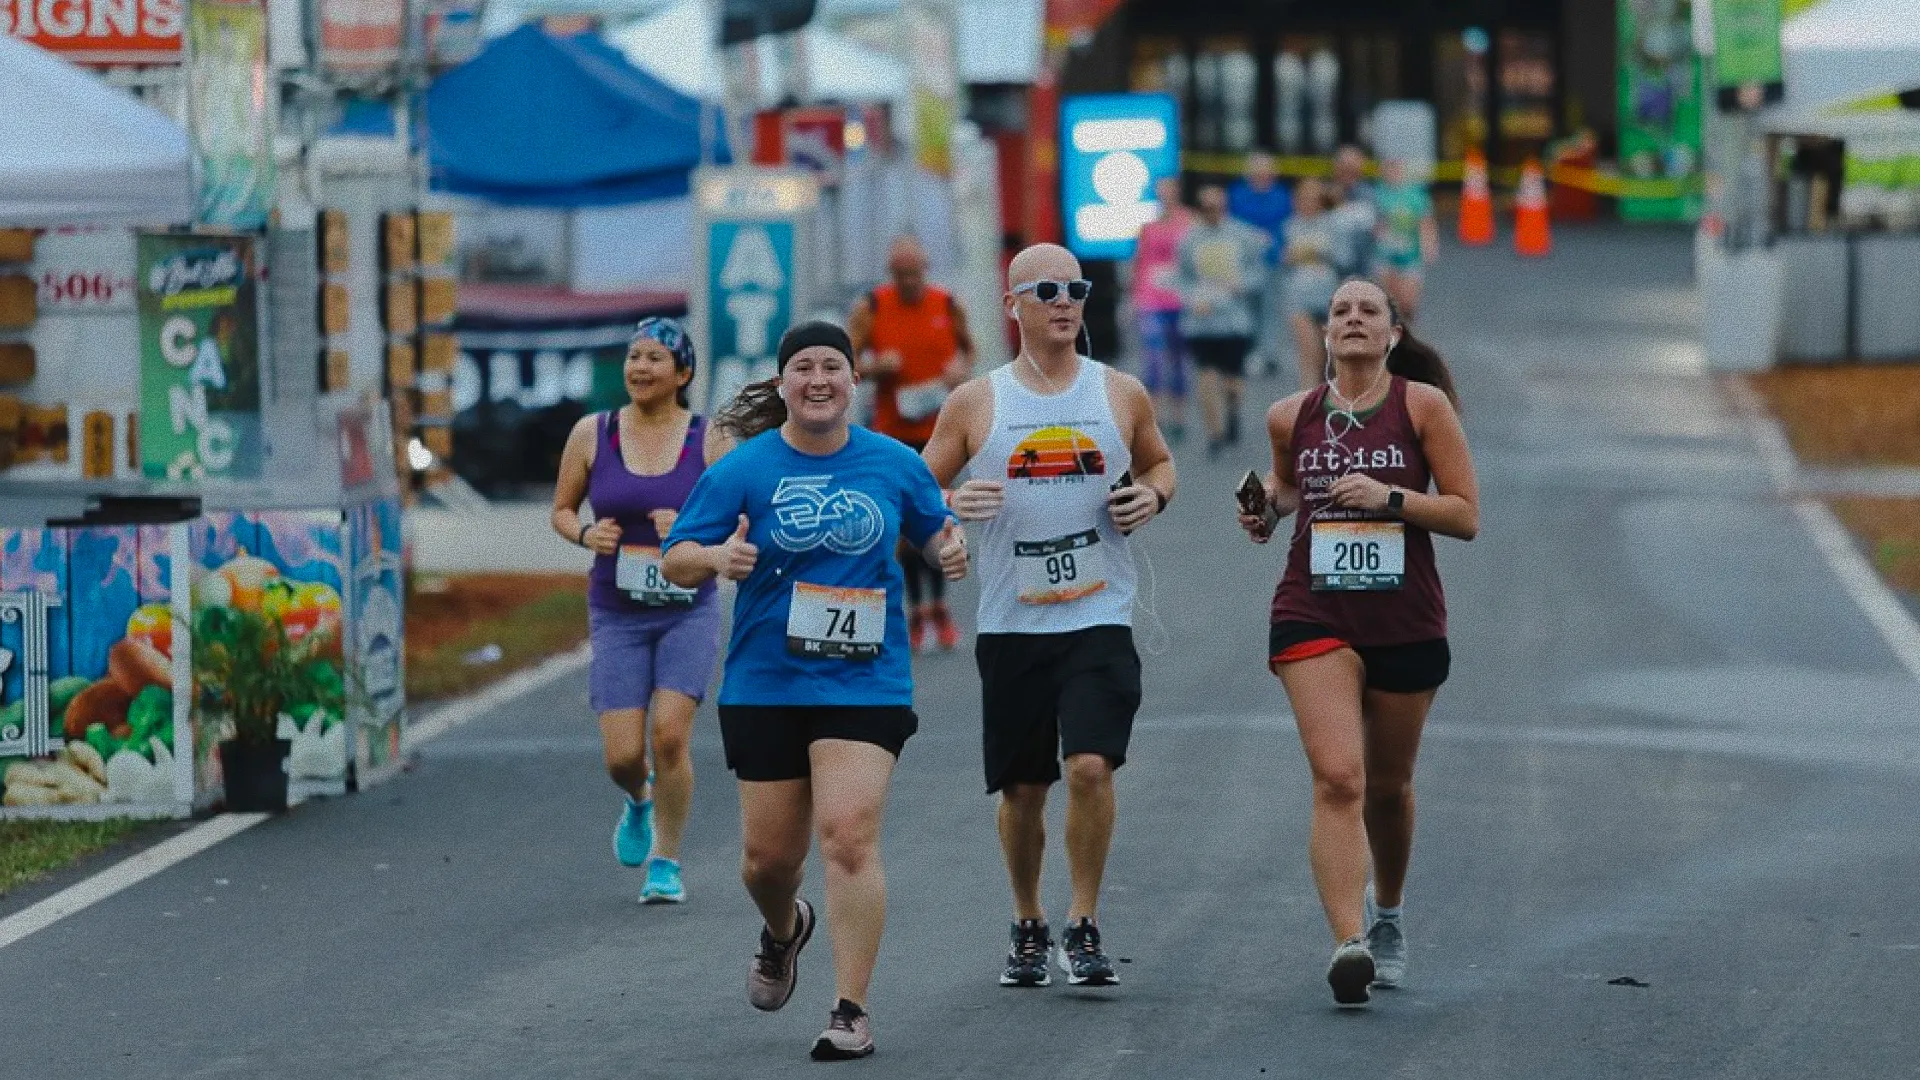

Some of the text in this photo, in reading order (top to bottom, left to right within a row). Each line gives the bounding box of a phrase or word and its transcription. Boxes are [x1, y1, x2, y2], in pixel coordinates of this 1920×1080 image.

[1046, 553, 1077, 585] 99
[1334, 542, 1380, 572] 206
[825, 607, 858, 641] 74
